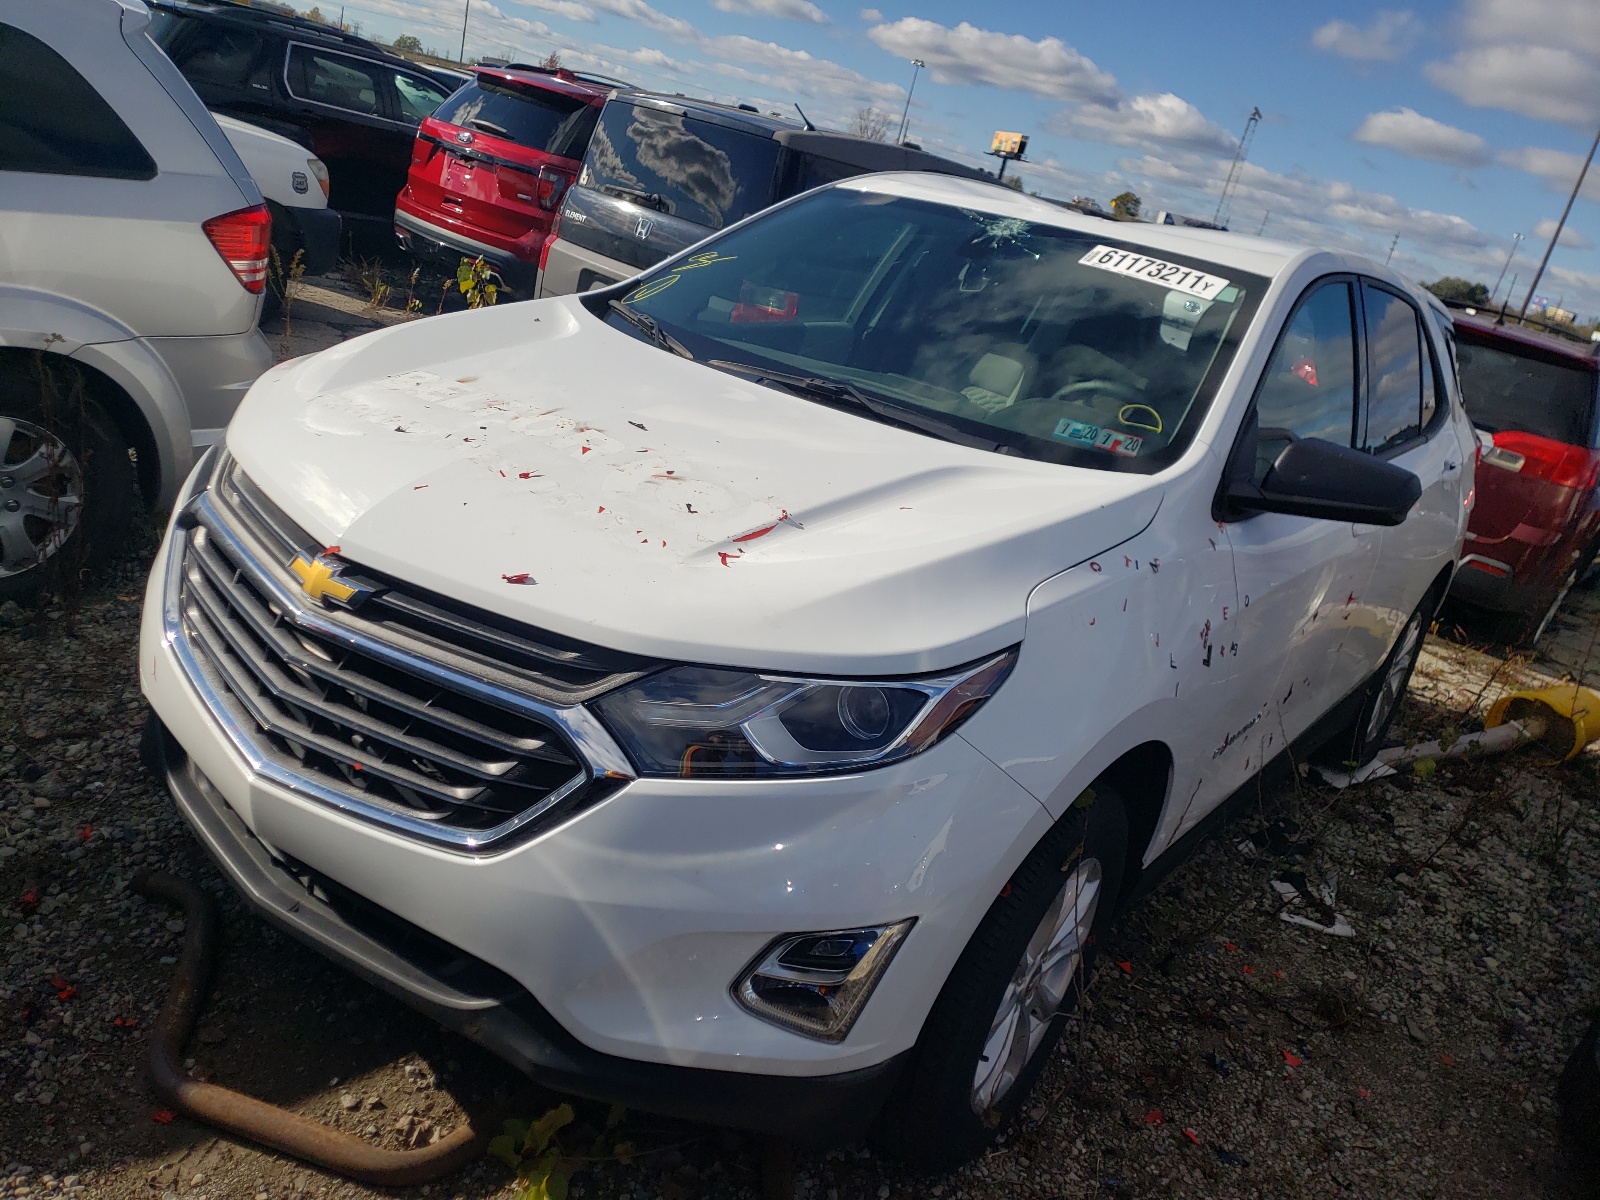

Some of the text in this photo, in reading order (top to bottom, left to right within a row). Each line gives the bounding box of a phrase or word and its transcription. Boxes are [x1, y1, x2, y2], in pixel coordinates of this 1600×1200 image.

[565, 209, 587, 223] ELEMENT
[1083, 426, 1099, 440] 20
[1124, 437, 1139, 452] 20
